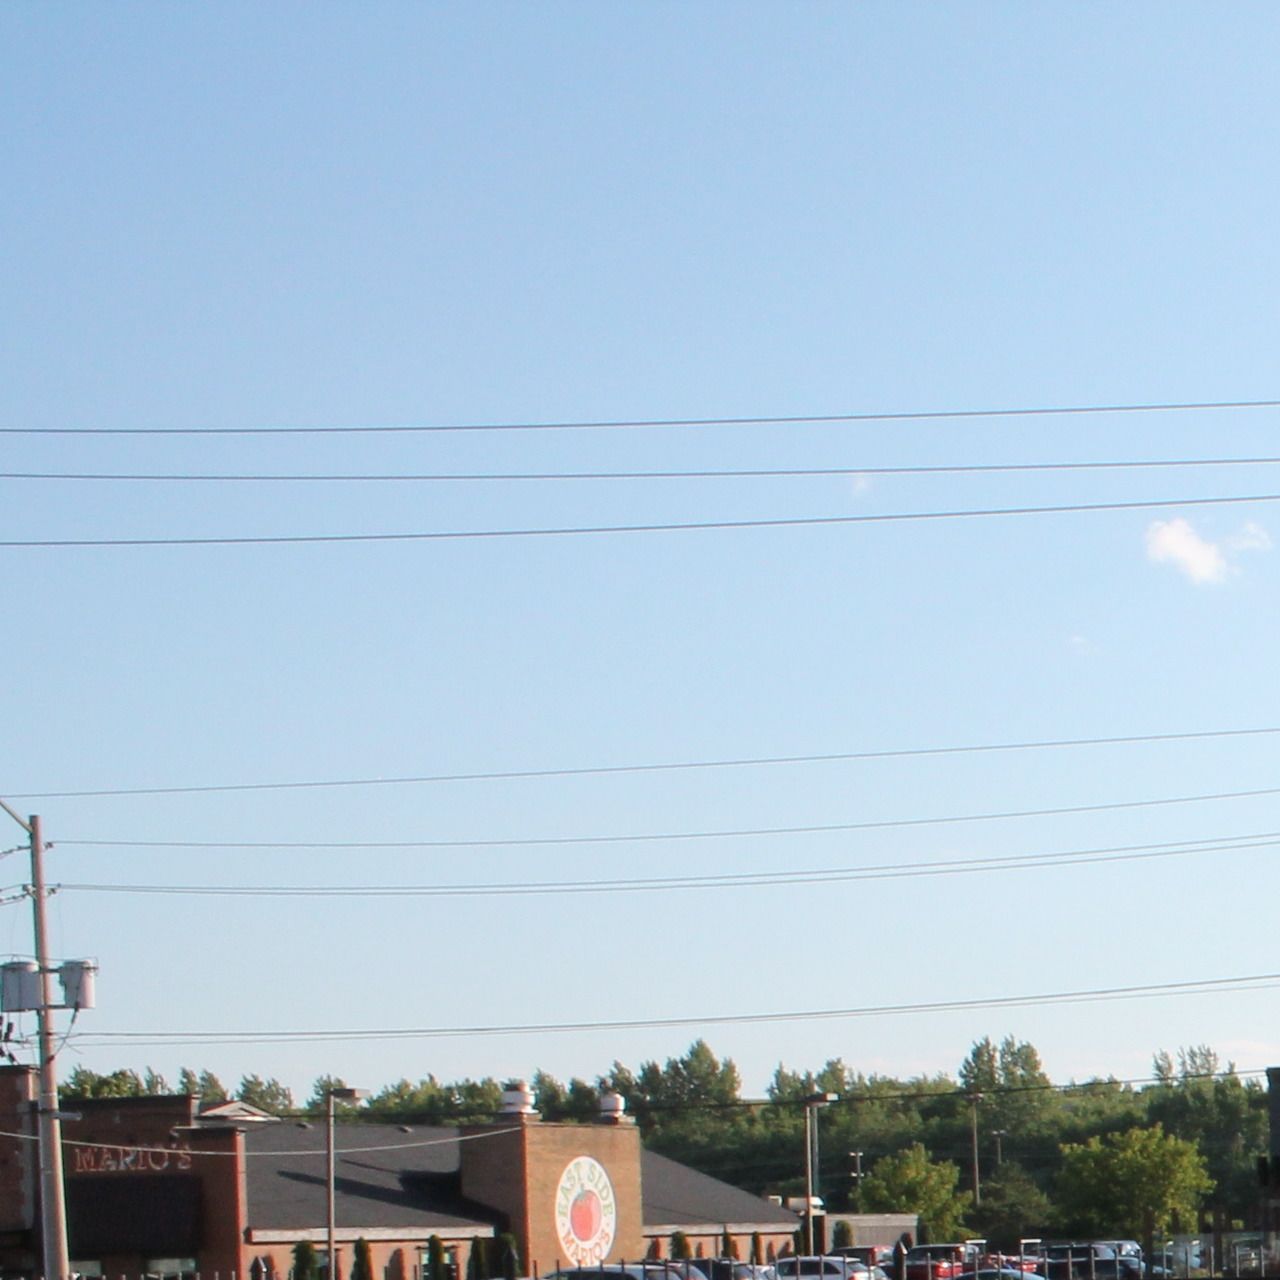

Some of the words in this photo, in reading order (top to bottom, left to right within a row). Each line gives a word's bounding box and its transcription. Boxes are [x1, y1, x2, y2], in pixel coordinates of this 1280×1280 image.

[75, 1142, 193, 1172] MARIO'S
[557, 1161, 582, 1218] EAST
[587, 1161, 613, 1217] SIDE
